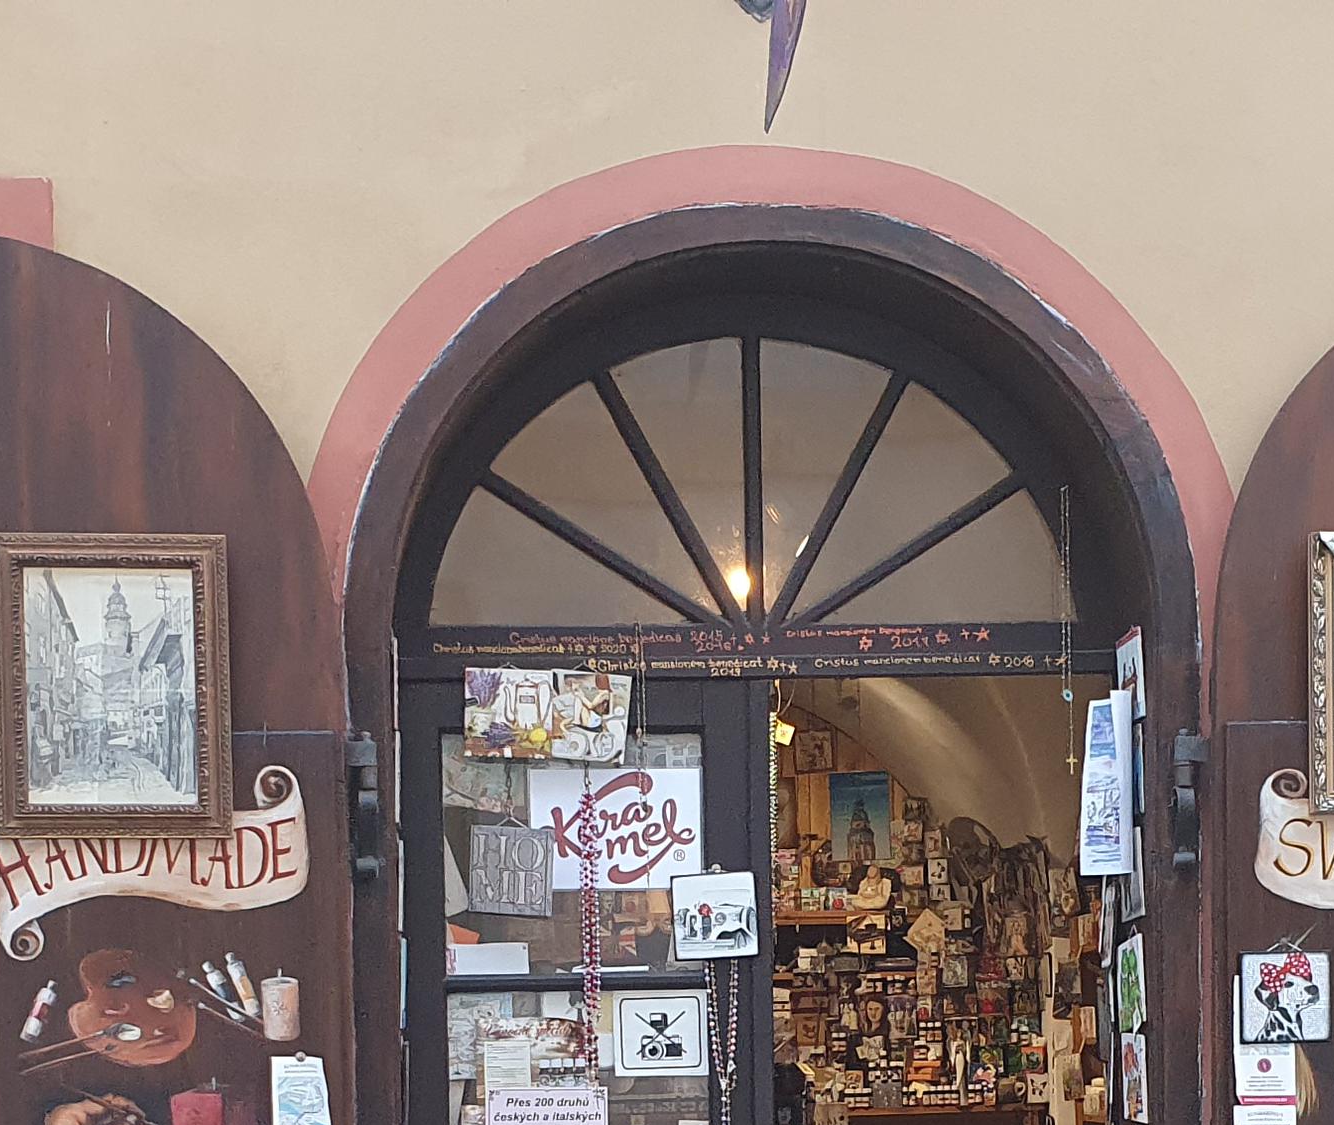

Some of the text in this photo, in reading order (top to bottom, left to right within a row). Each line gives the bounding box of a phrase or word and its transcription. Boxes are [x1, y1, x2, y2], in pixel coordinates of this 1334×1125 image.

[507, 1096, 589, 1108] Přes 200 druhů
[494, 1111, 539, 1124] českých
[553, 1111, 601, 1123] italských
